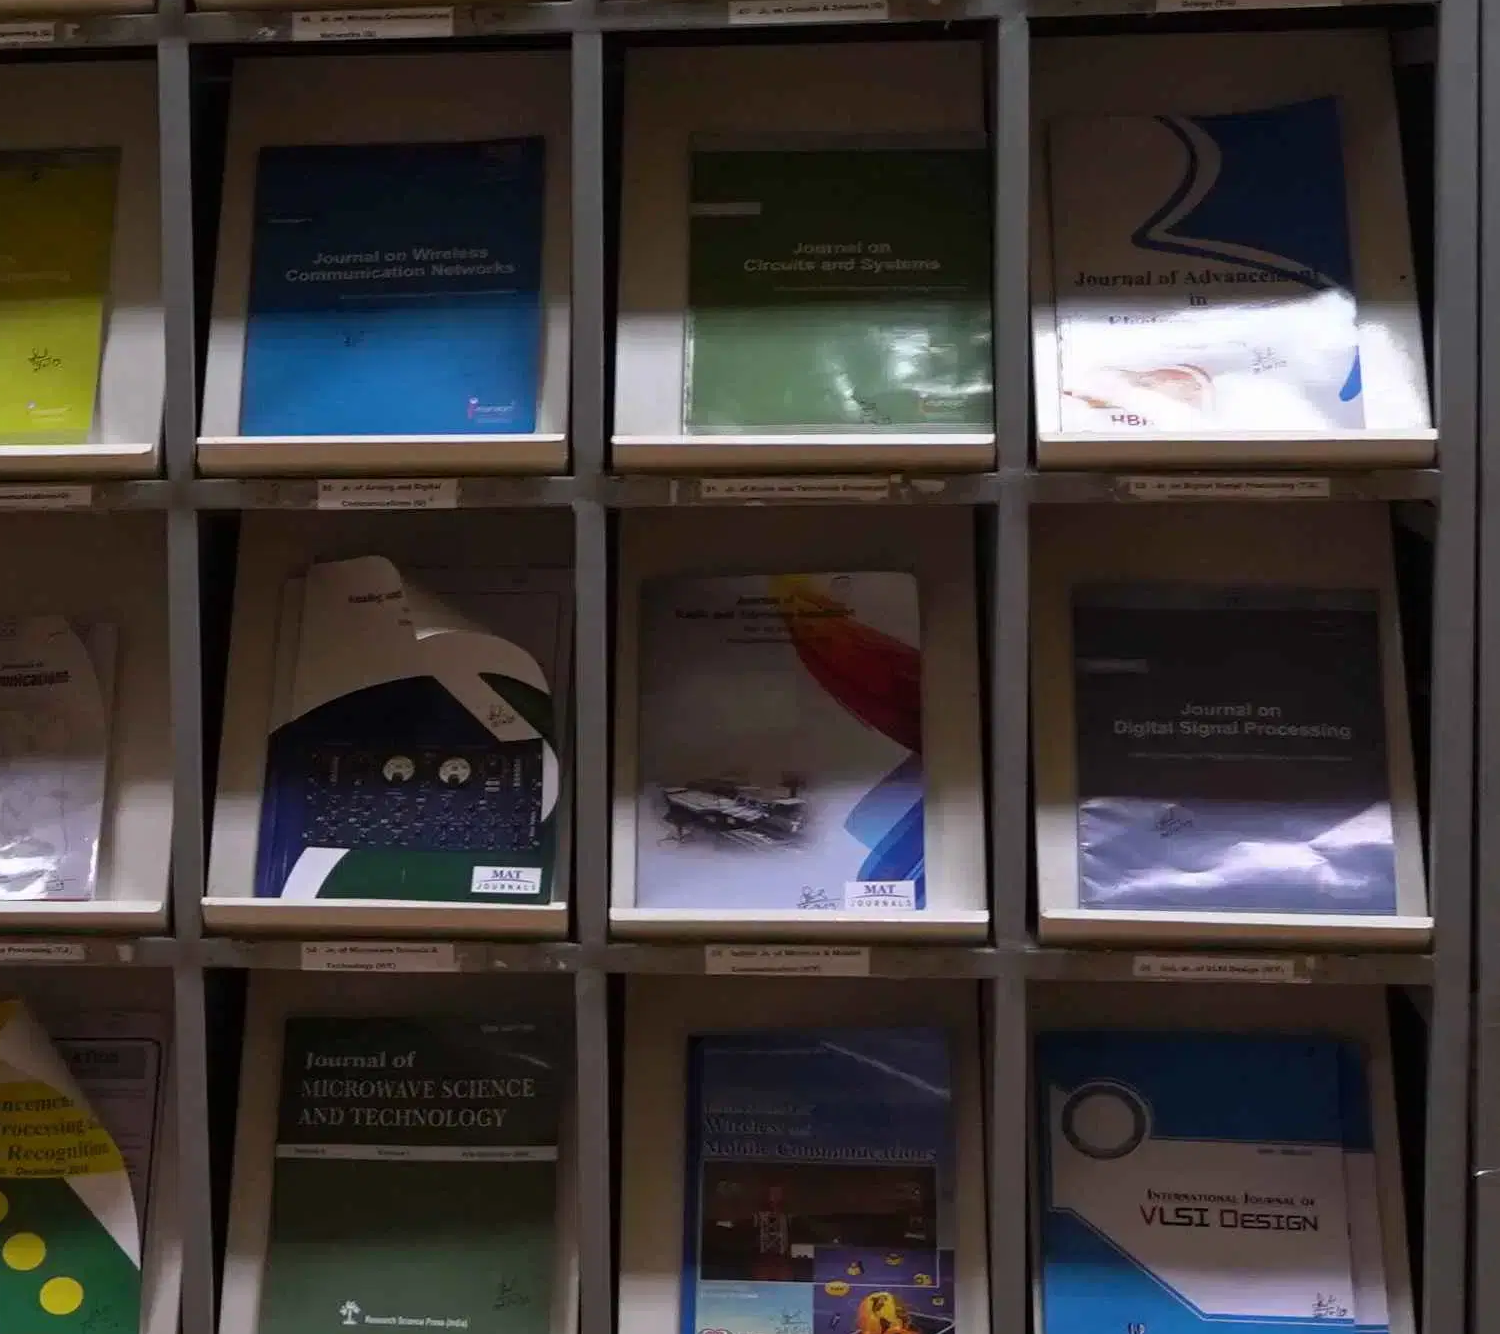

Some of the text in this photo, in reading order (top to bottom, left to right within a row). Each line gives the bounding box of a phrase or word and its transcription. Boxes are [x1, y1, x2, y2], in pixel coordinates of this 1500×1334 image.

[311, 245, 490, 267] Journal on Wireless
[791, 240, 893, 257] Journal on
[285, 261, 517, 284] Communication Networks
[1188, 292, 1208, 307] in
[1179, 701, 1283, 718] Journal on
[1112, 718, 1353, 741] Digital Signal Processing
[490, 868, 522, 881] MAT
[863, 882, 897, 896] MAT
[302, 1049, 417, 1071] Journal of
[296, 1077, 537, 1100] MICROWAVE SCIENCE
[295, 1106, 508, 1129] AND TECHNOLOGY
[1138, 1203, 1320, 1234] VLSI DESIGN
